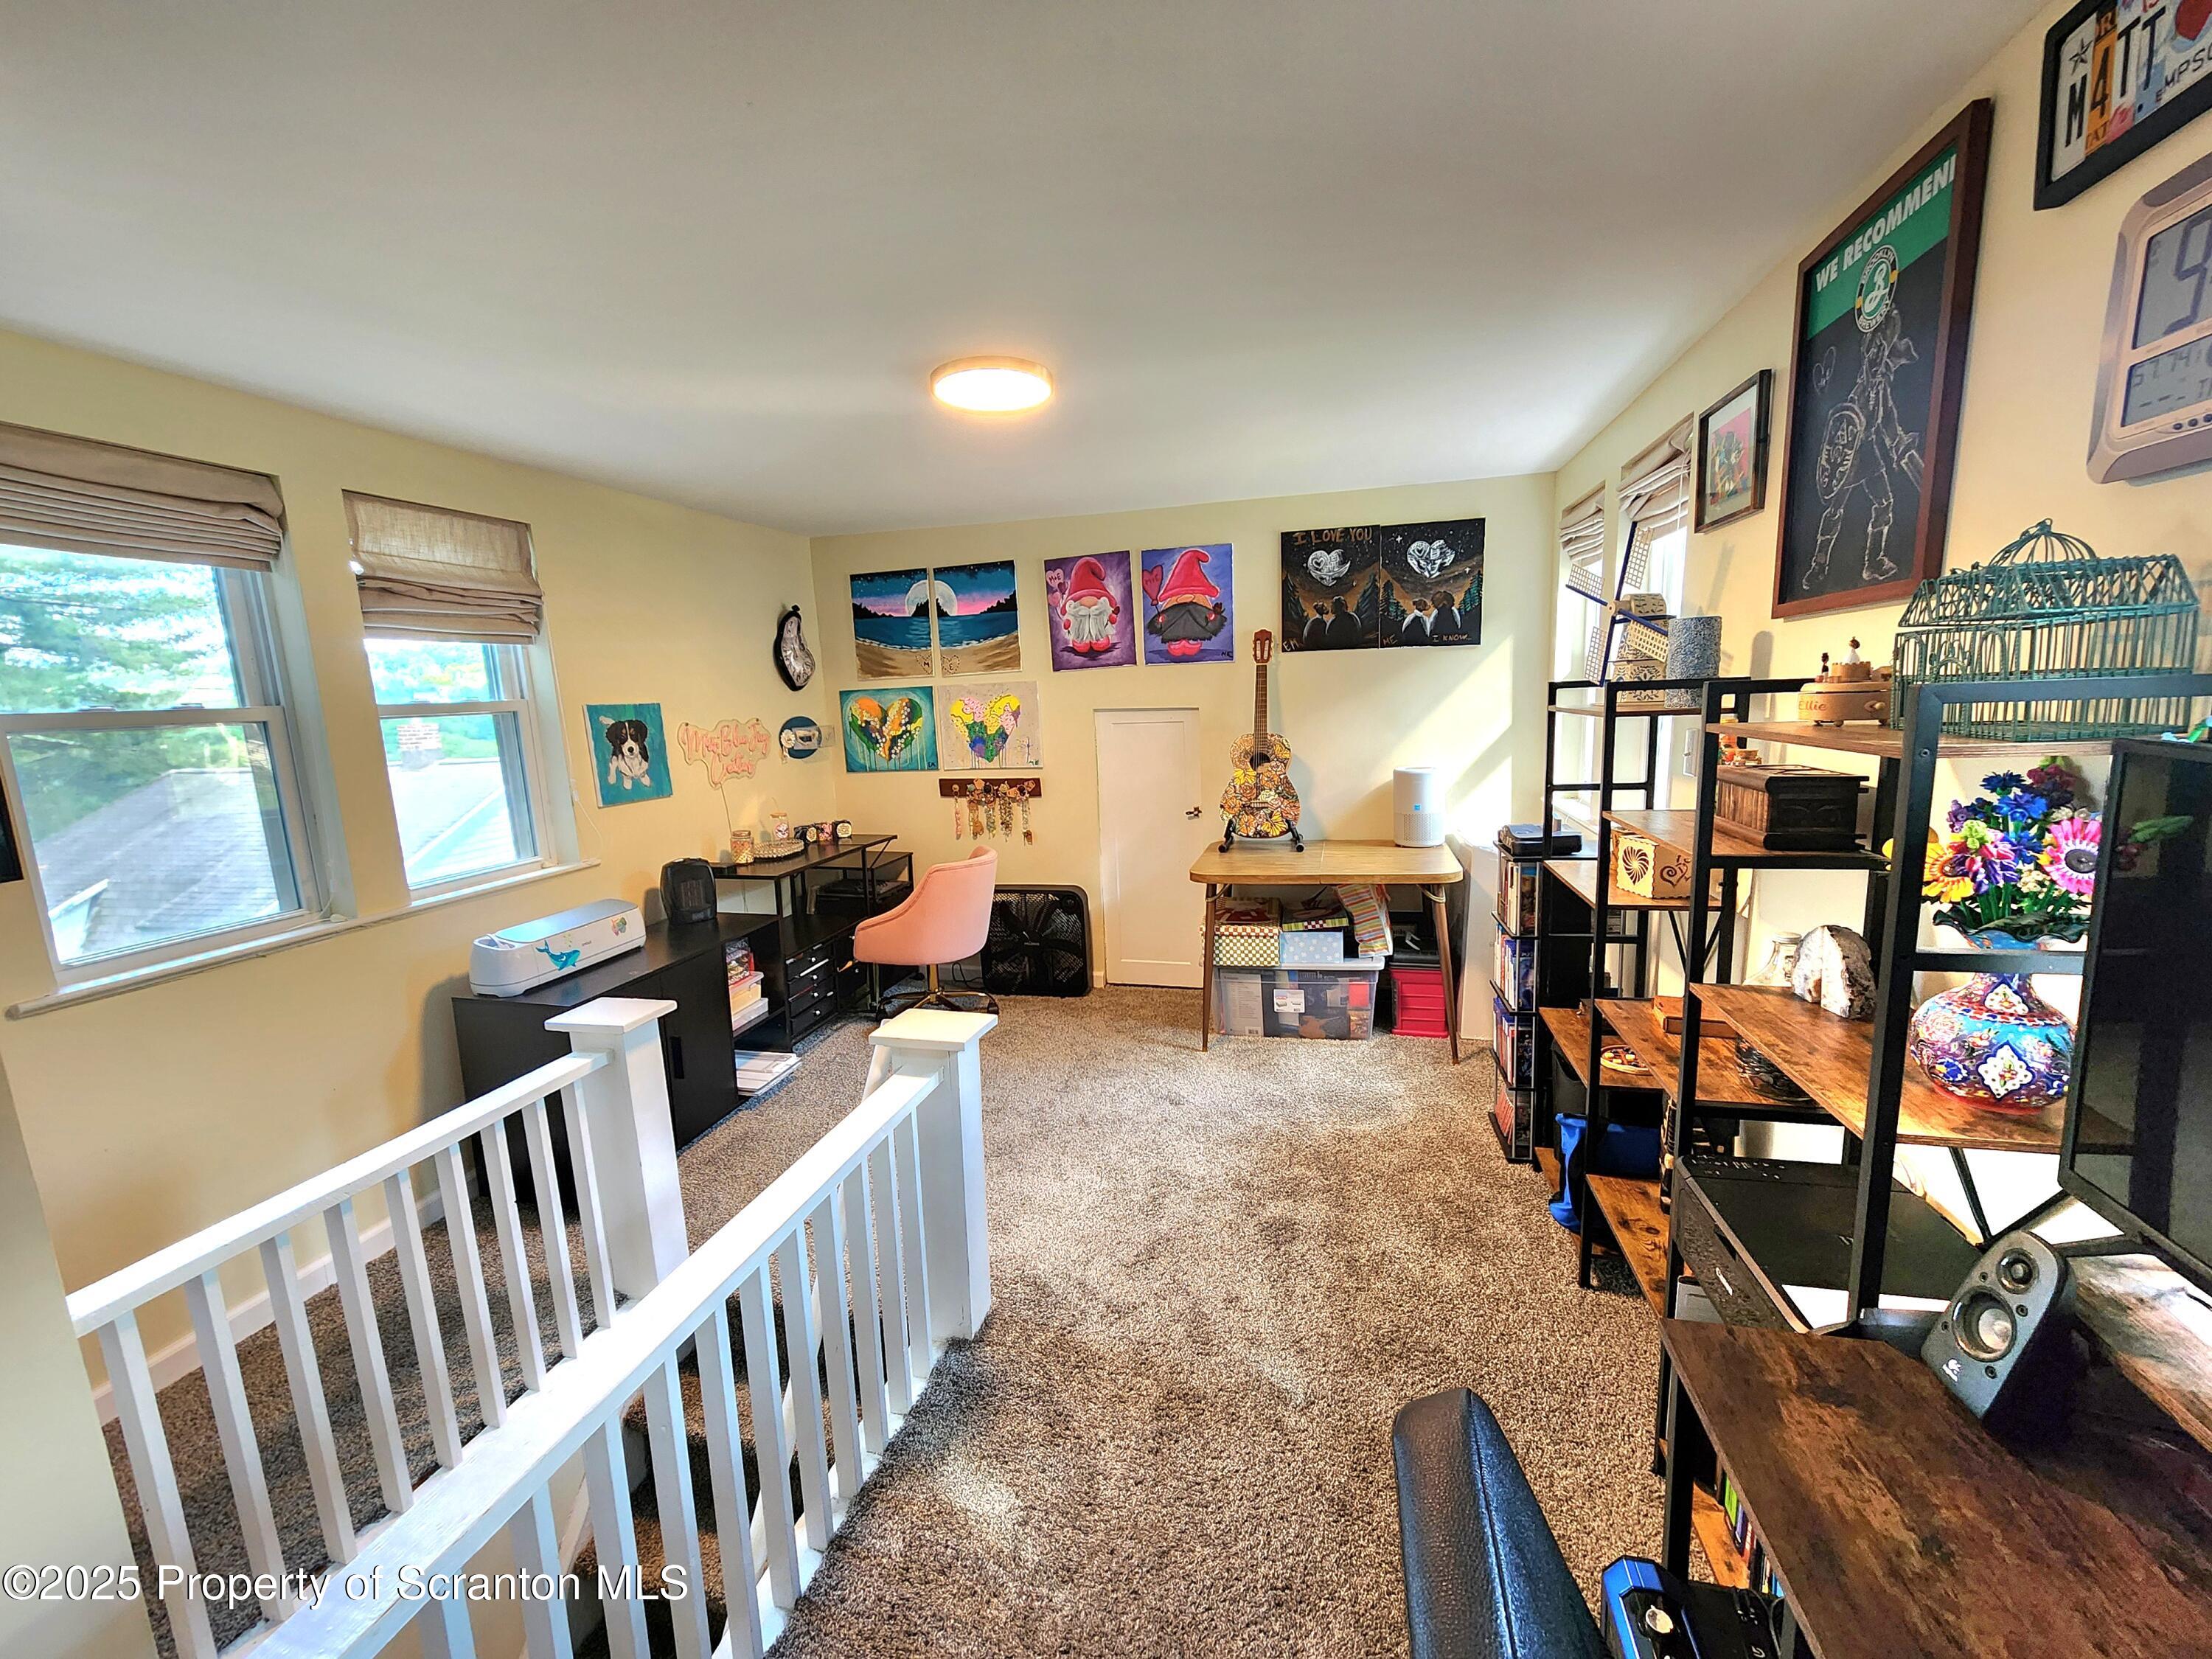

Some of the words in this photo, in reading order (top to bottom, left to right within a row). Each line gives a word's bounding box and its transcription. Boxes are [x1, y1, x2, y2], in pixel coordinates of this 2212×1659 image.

[1816, 257, 1839, 292] WE
[1293, 532, 1307, 546] I
[1311, 528, 1345, 543] LOVE
[1349, 526, 1373, 543] YOU
[1798, 700, 1827, 712] Ellie
